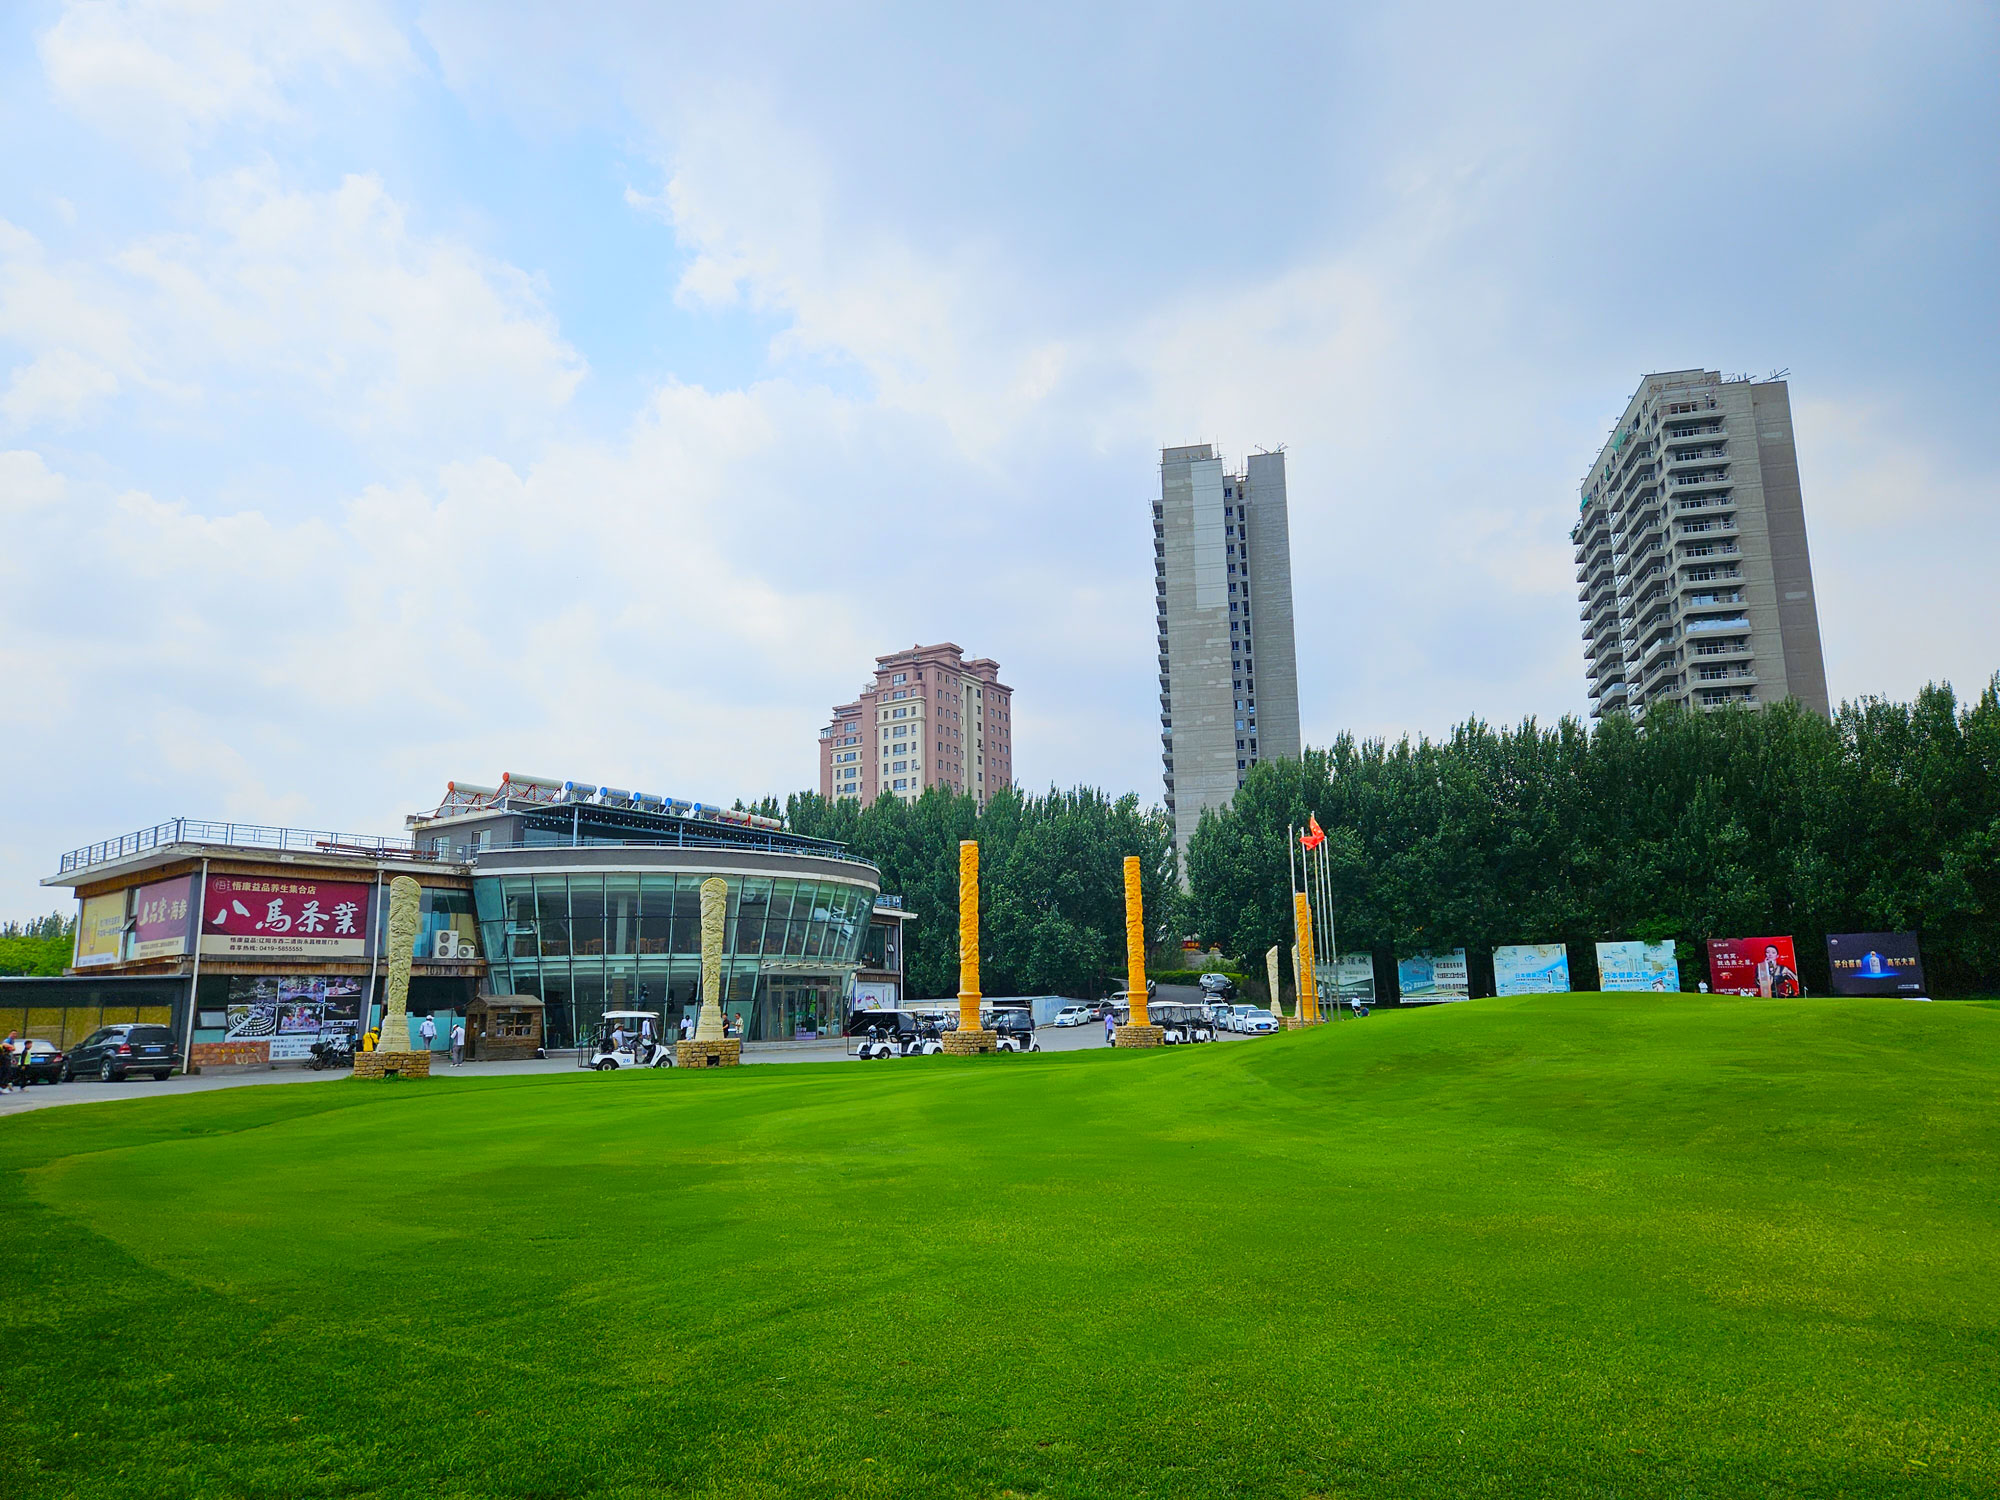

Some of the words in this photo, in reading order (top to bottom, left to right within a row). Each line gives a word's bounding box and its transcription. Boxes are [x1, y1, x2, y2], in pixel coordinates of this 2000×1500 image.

[232, 881, 317, 895] 悟康益品养生集合店
[212, 897, 359, 935] 八馬茶業
